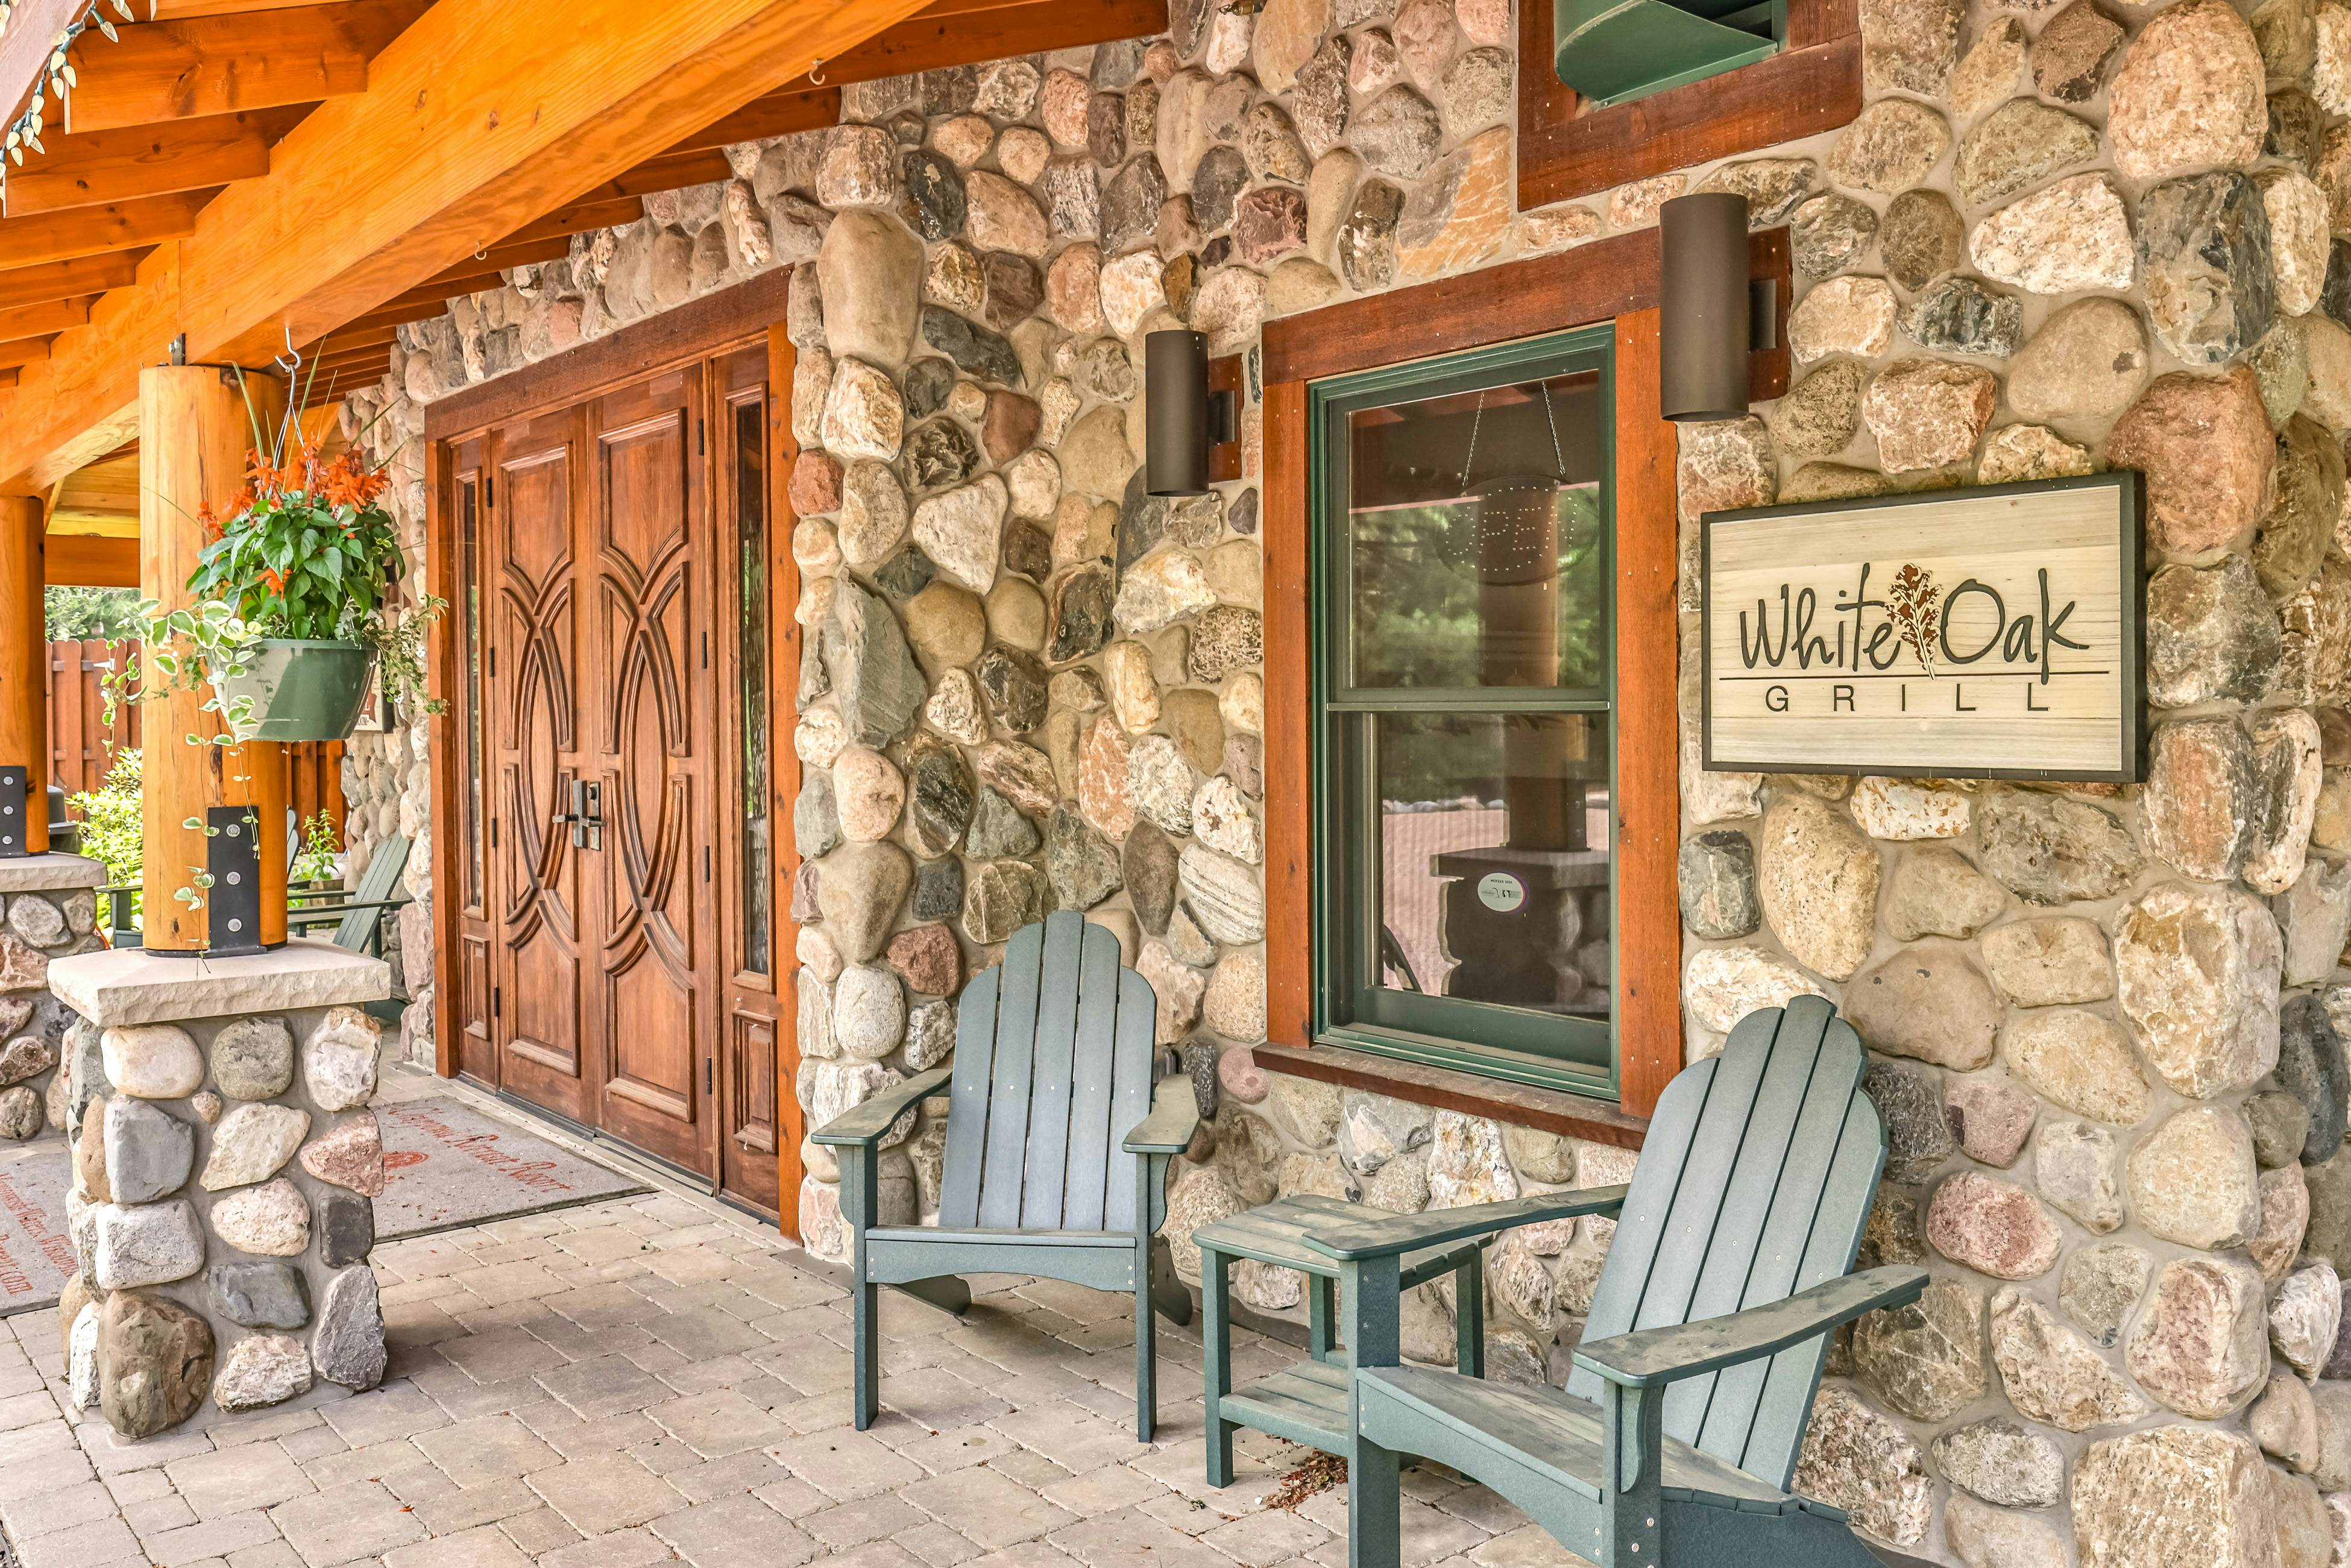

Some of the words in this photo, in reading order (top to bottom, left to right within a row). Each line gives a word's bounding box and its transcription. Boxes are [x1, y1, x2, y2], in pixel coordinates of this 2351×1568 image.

[1446, 503, 1577, 555] OPEN
[1739, 562, 1902, 672] White
[1939, 567, 2091, 685] Oak
[1764, 682, 2049, 712] GRILL
